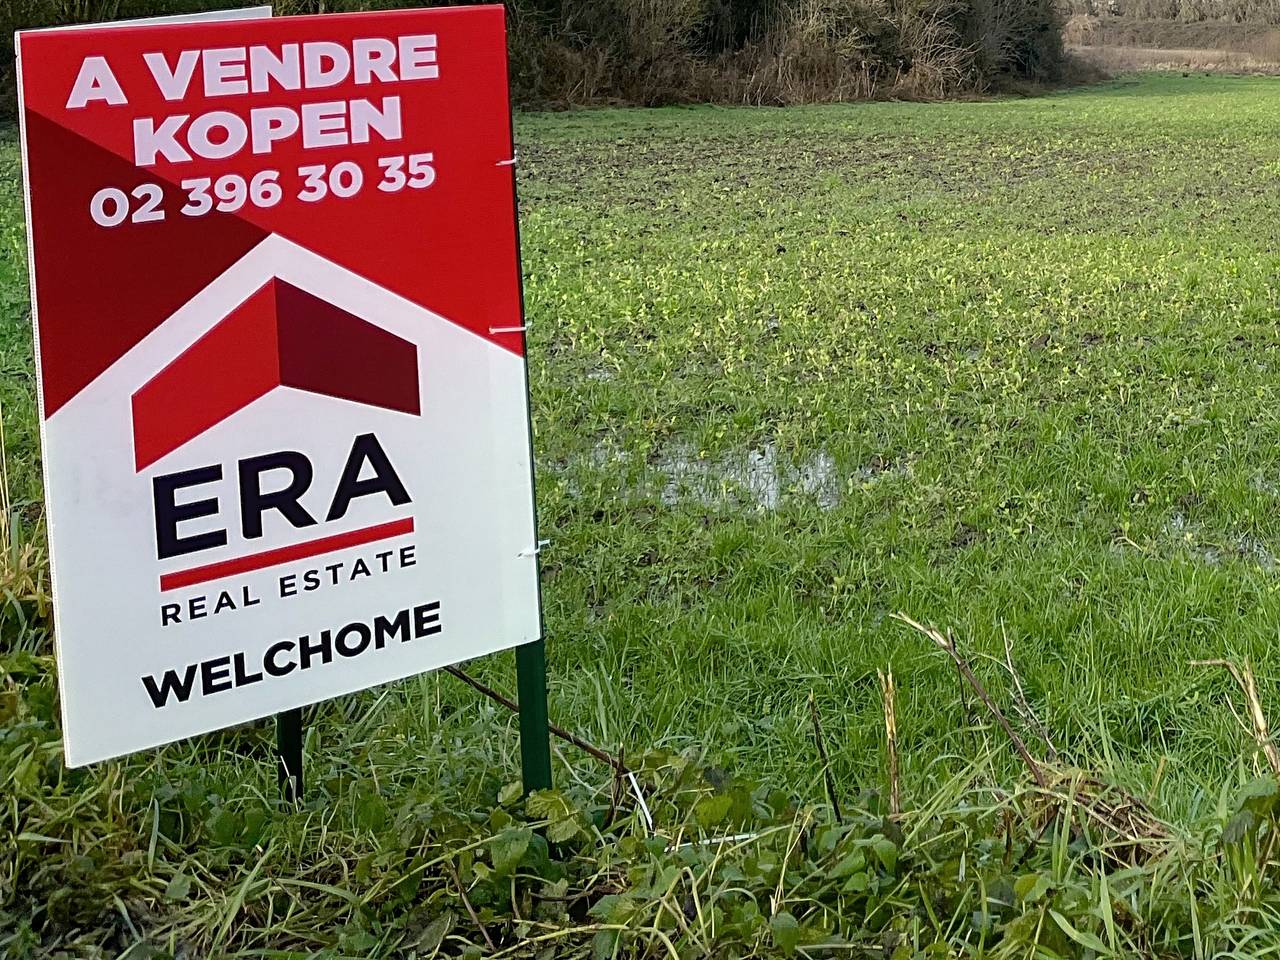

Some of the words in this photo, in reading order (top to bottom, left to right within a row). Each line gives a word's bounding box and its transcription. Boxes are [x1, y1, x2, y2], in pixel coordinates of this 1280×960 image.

[66, 56, 128, 109] A
[143, 34, 439, 101] VENDRE
[132, 96, 402, 167] KOPEN
[90, 183, 165, 227] 02
[180, 169, 282, 217] 396
[297, 161, 363, 202] 30
[377, 152, 436, 193] 35
[151, 432, 413, 561] ERA
[160, 585, 260, 627] REAL
[279, 545, 417, 598] ESTATE
[141, 600, 442, 709] WELCHOME
